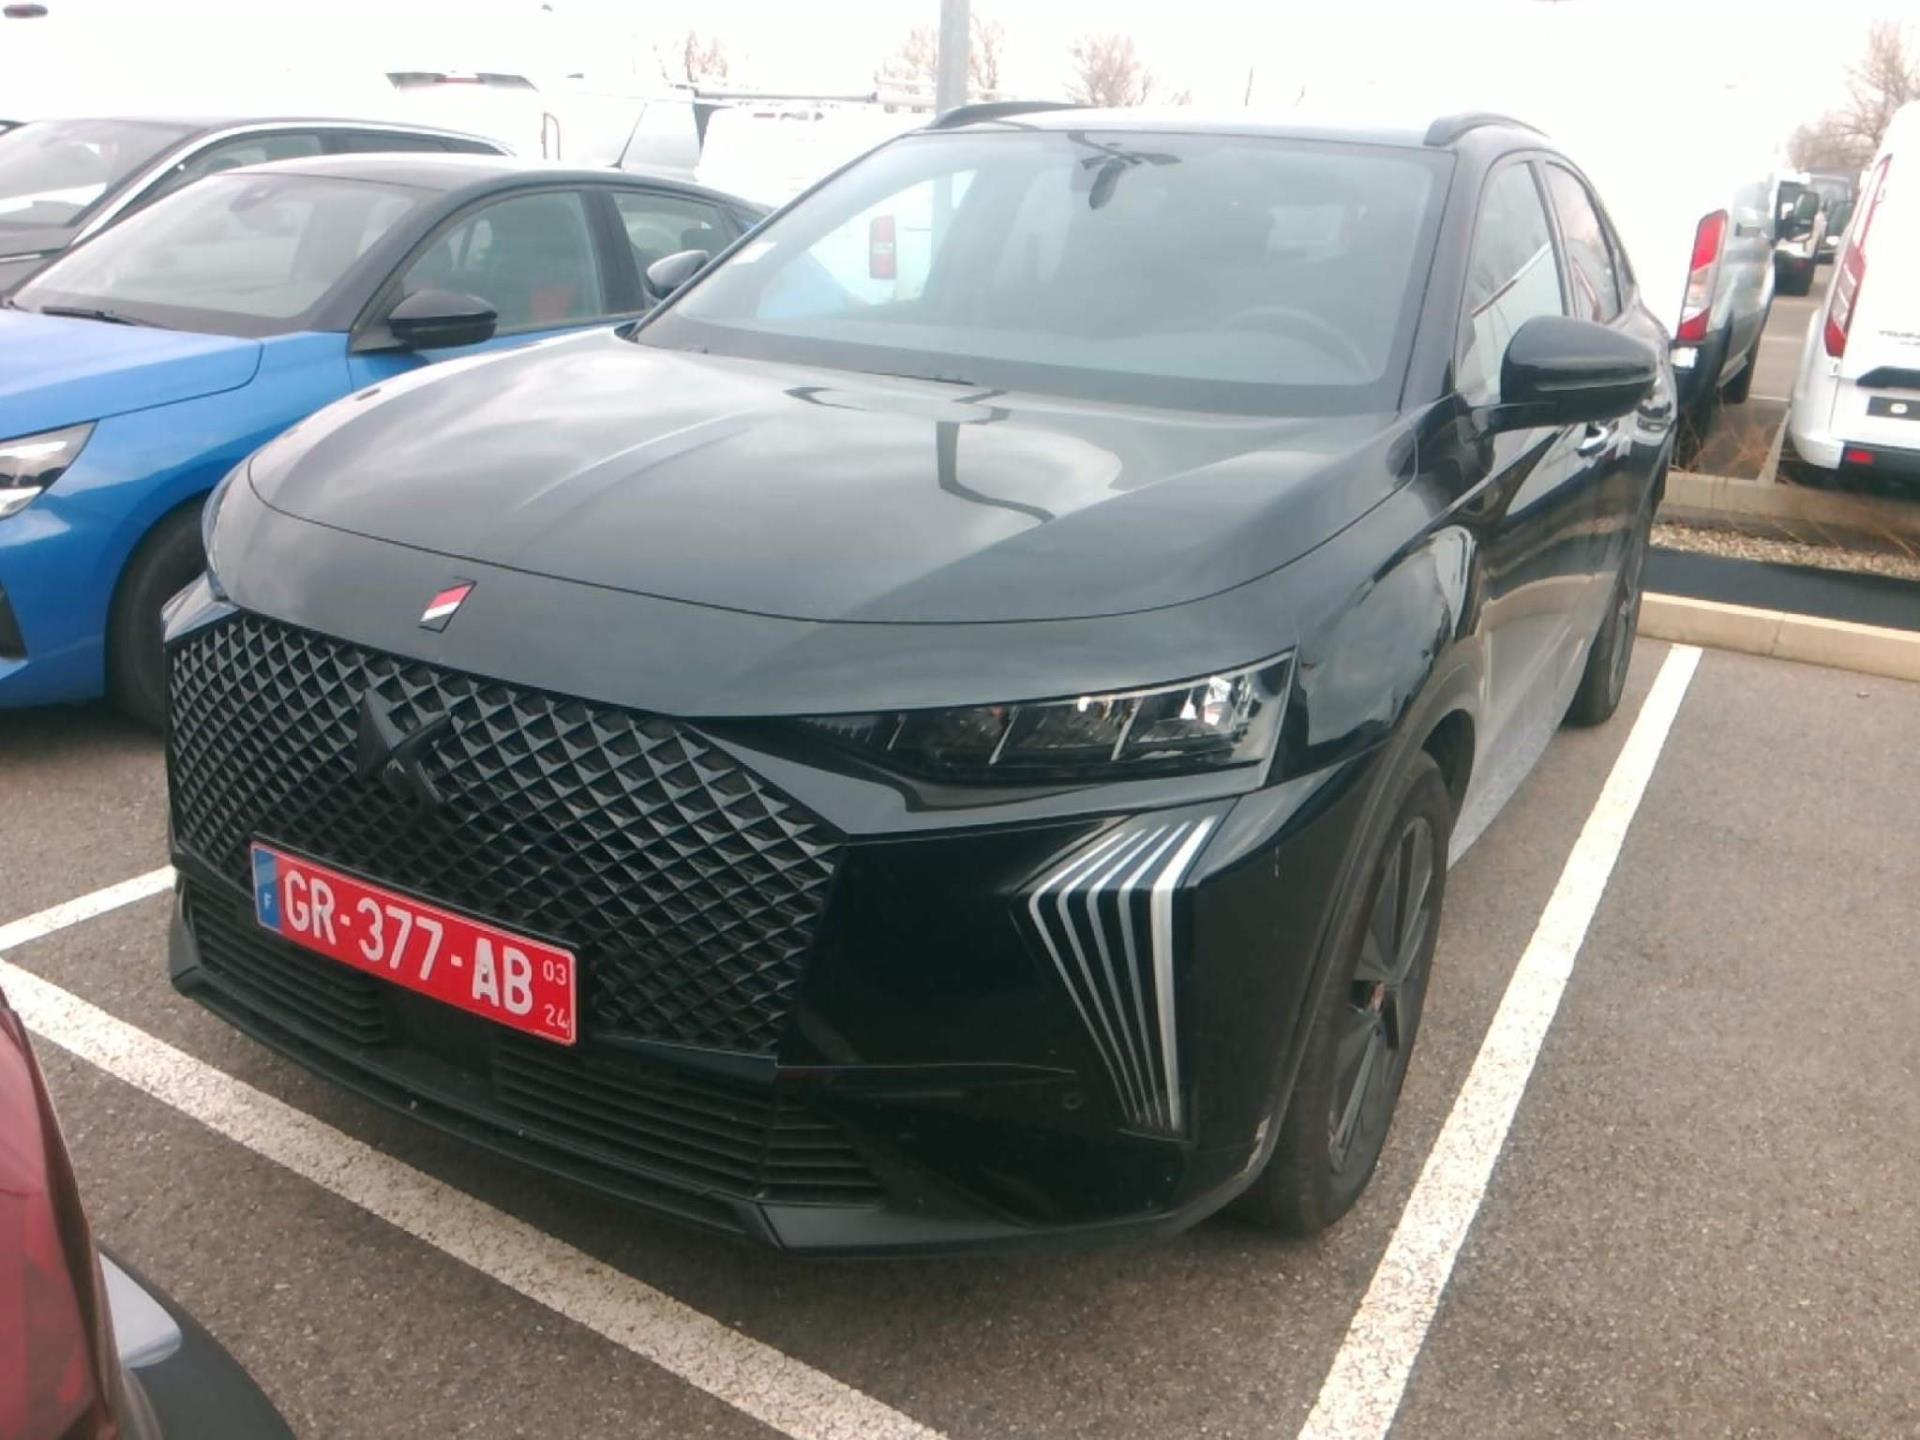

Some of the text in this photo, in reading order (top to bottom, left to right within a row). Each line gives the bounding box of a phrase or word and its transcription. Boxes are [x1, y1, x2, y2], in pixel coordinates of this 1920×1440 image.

[284, 869, 533, 1016] GR-377-AB
[543, 959, 568, 986] 03
[543, 1003, 571, 1037] 24
